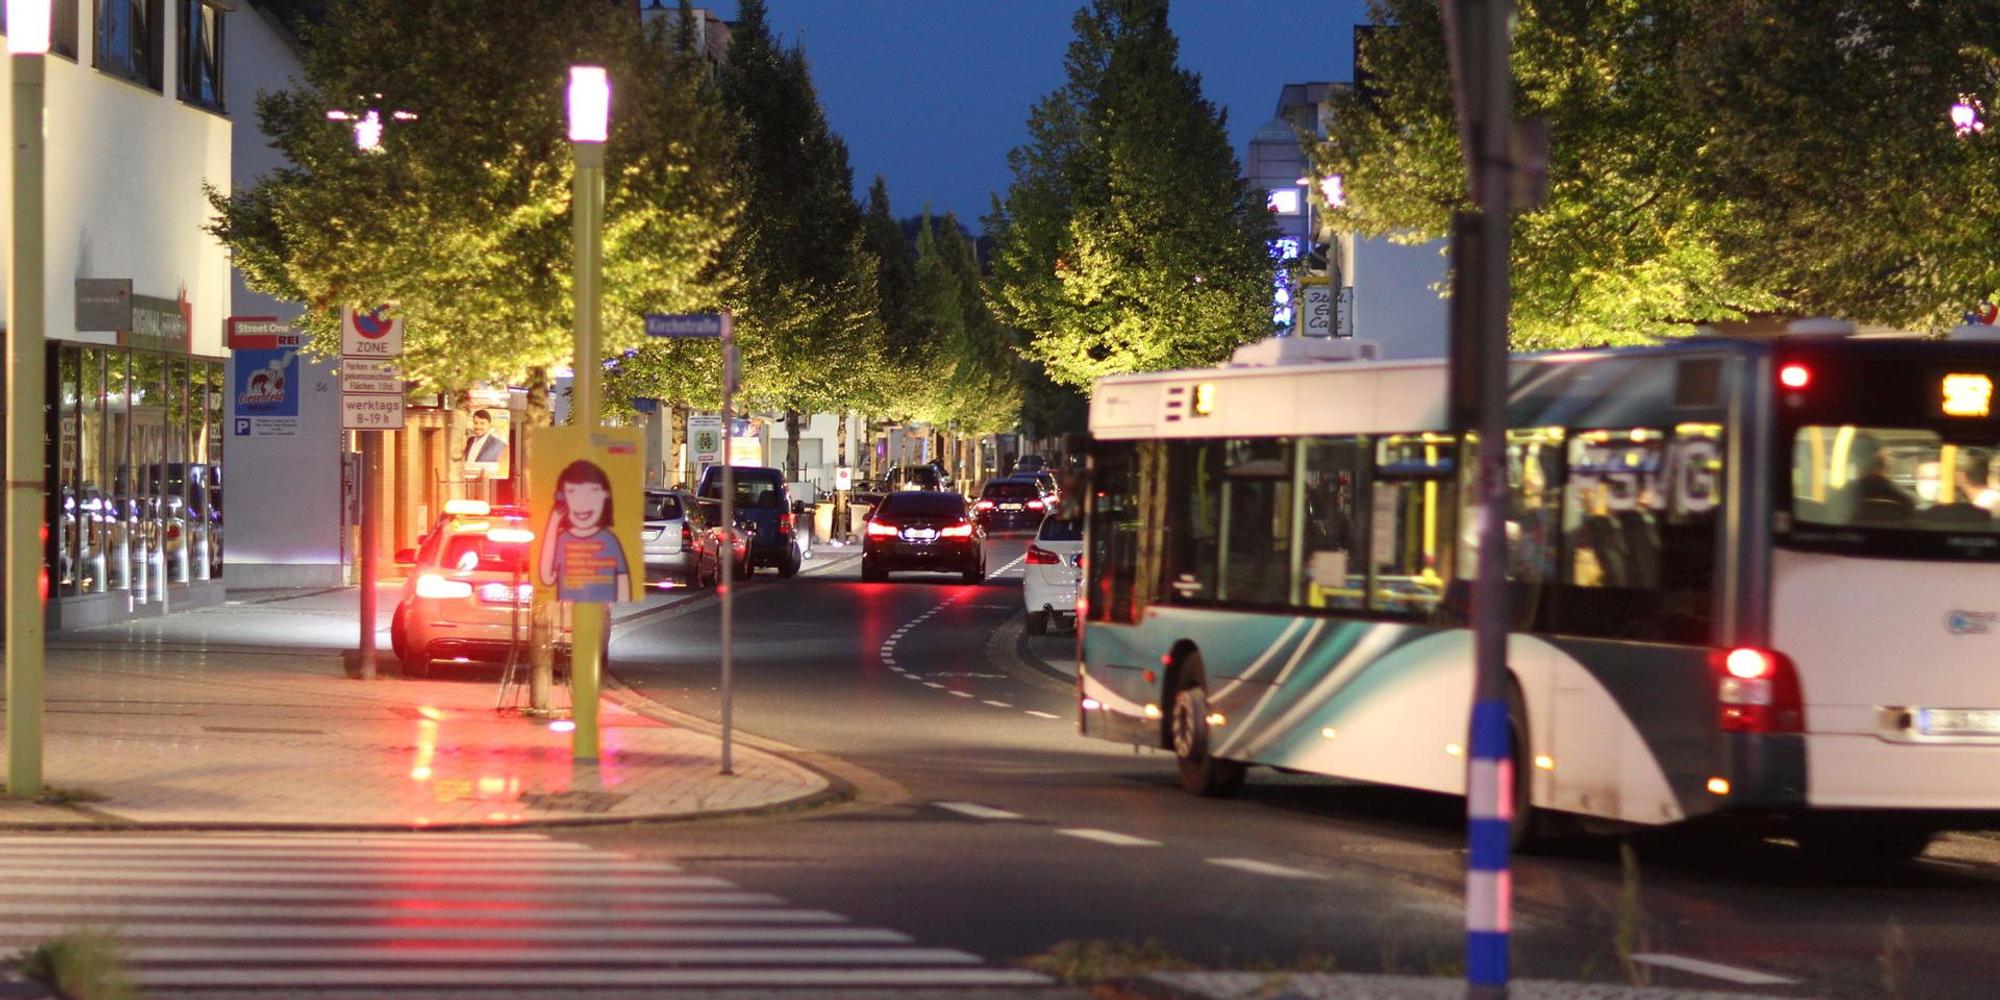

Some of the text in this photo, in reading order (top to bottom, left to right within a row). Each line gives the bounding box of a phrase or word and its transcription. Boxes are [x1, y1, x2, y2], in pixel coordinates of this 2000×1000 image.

[238, 323, 268, 333] Street
[1309, 316, 1344, 329] Caé
[357, 342, 388, 353] ZONE
[346, 401, 399, 413] werktags
[383, 413, 389, 424] h
